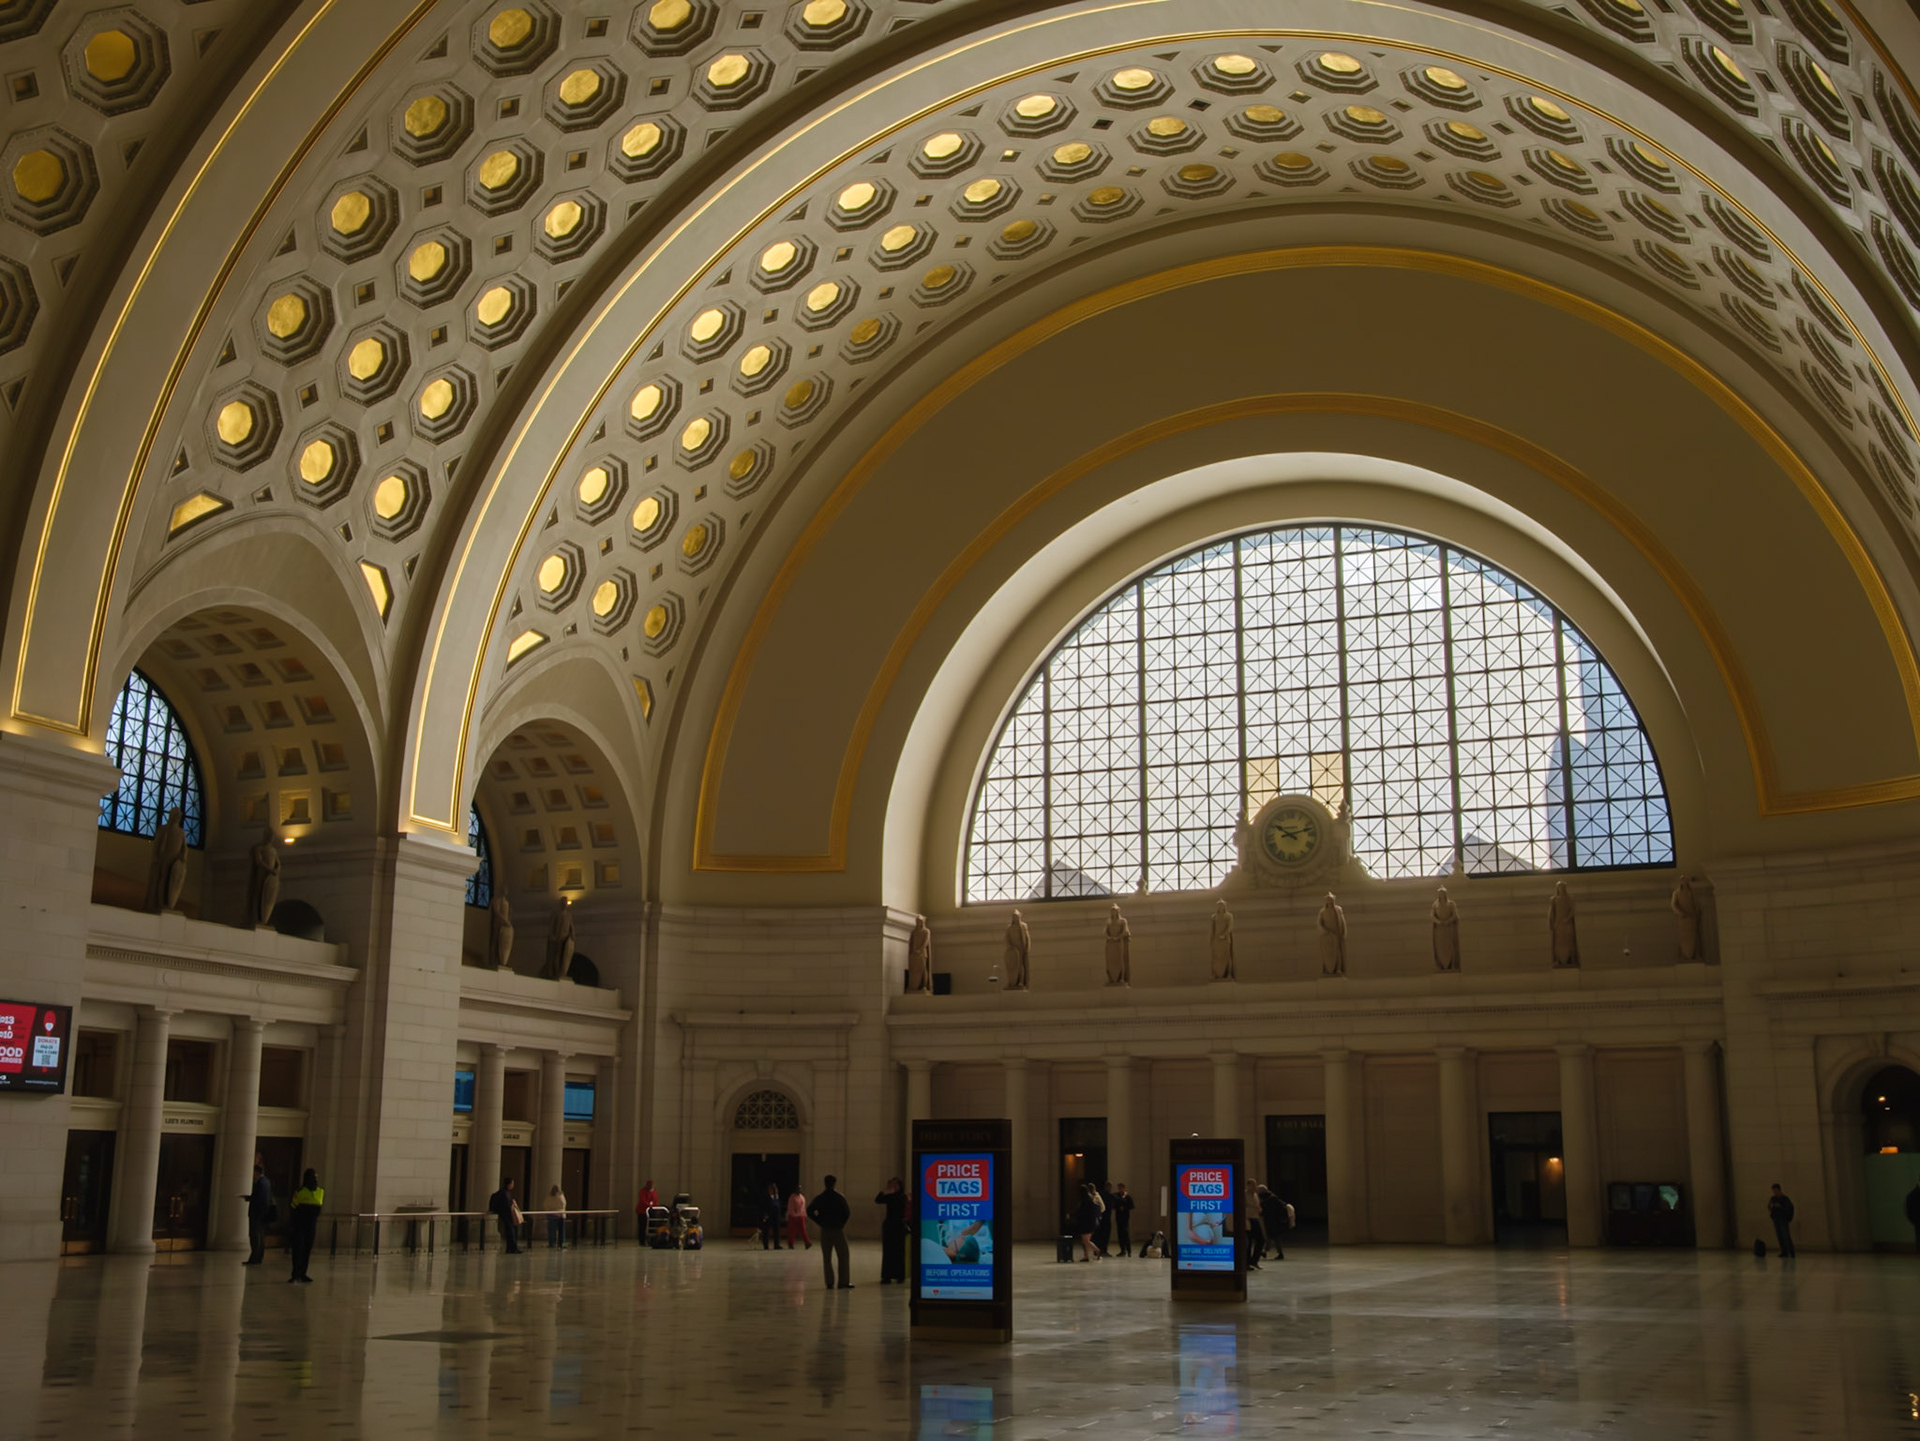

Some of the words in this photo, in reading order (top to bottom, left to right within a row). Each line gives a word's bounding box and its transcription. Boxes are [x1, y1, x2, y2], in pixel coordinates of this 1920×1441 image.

[937, 1163, 980, 1177] PRICE
[1189, 1171, 1222, 1182] PRICE
[938, 1180, 980, 1194] TAGS
[1190, 1184, 1222, 1194] TAGS
[938, 1203, 980, 1216] FIRST
[1190, 1200, 1222, 1211] FIRST
